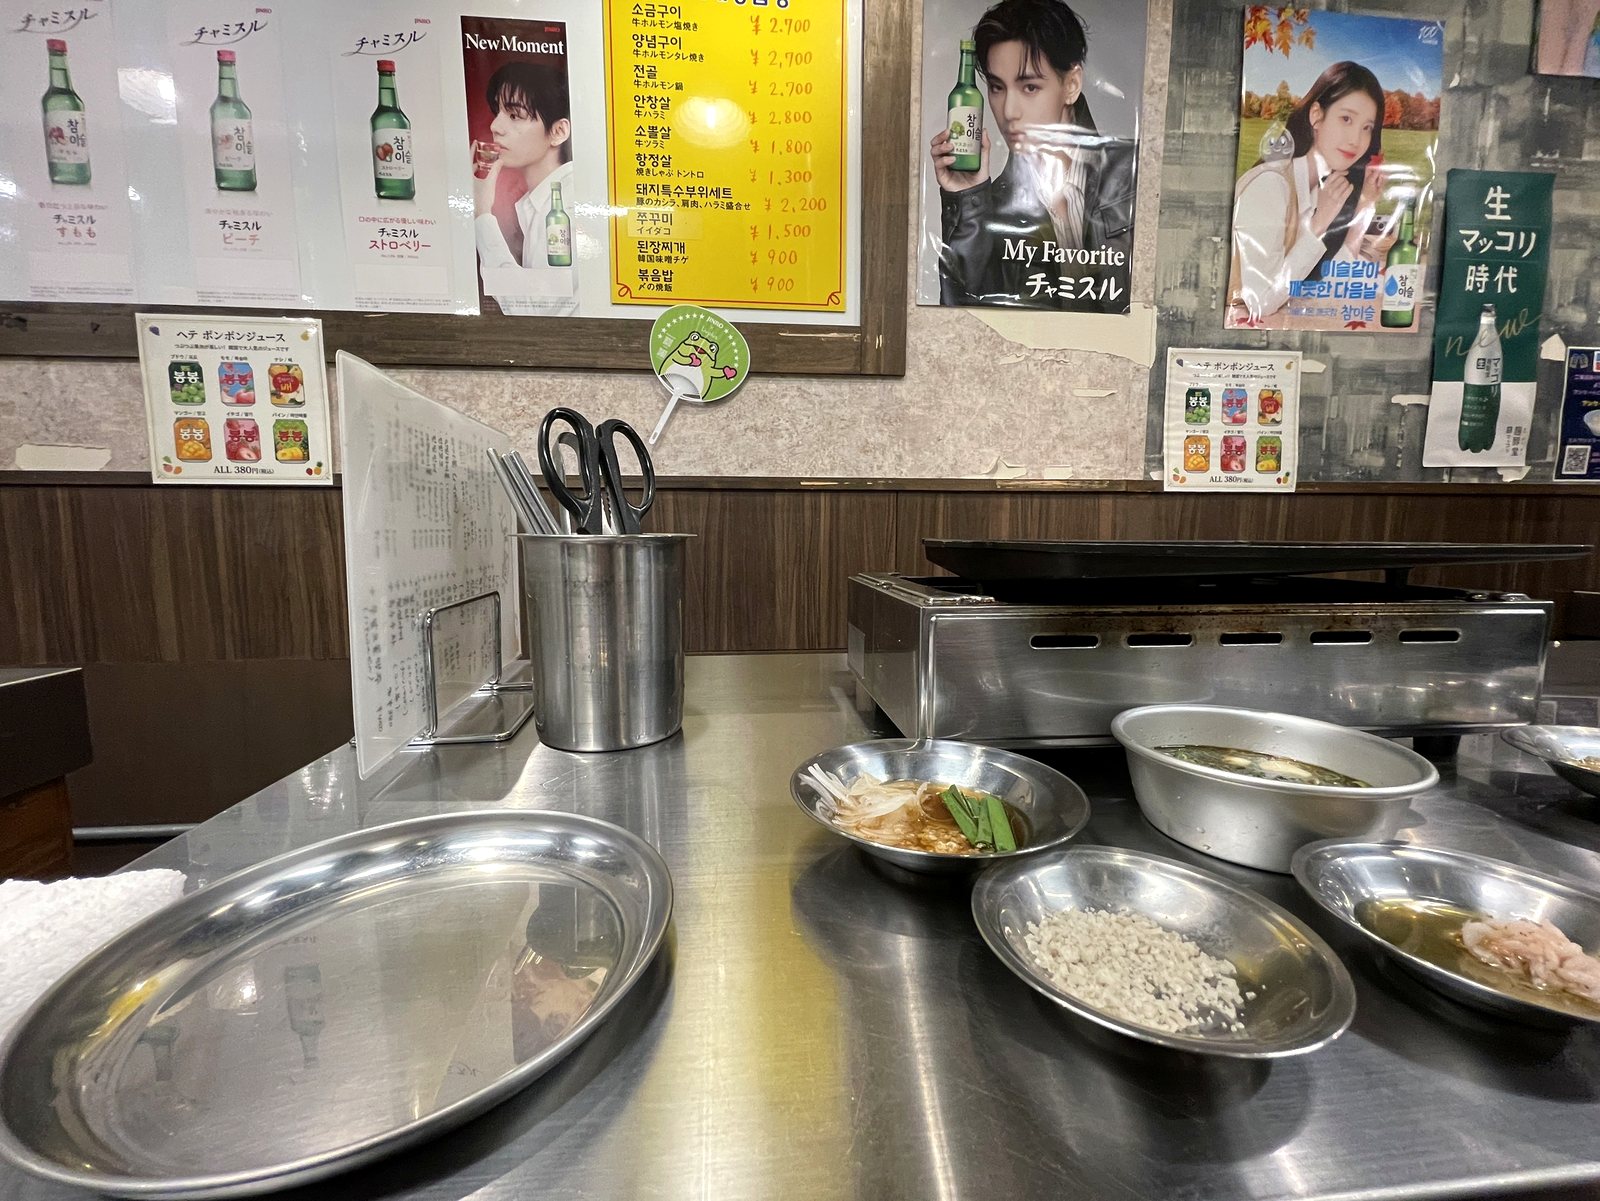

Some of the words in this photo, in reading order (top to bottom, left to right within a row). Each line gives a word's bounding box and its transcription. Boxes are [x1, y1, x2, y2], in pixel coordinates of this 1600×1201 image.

[632, 3, 681, 19] 소금구이
[14, 8, 98, 33] チャミスル
[632, 18, 699, 31] 牛ホルモン塩焼き
[187, 20, 268, 44] チャミスル
[348, 31, 426, 55] チャミスル
[465, 33, 499, 50] New
[501, 35, 564, 54] Moment
[632, 34, 682, 50] 양념구이
[632, 49, 705, 63] 牛ホルモンタレ焼き
[633, 65, 658, 79] 전골
[633, 79, 684, 91] 牛ホルモン鍋
[633, 95, 671, 110] 안창살
[634, 109, 665, 120] 牛ハラミ
[635, 139, 665, 149] 牛ツラミ
[636, 153, 672, 168] 항정살
[636, 168, 674, 178] 焼きしゃぶ
[677, 170, 704, 179] トントロ
[636, 183, 733, 199] 돼지특수부위세트
[1484, 185, 1512, 220] 生
[53, 214, 97, 225] チャミスル
[219, 219, 262, 231] チャミスル
[636, 212, 673, 226] 쭈꾸미
[57, 226, 96, 238] すもも
[378, 227, 419, 239] チャミスル
[637, 227, 671, 237] イイダコ
[369, 239, 431, 252] ストロベリー
[637, 240, 686, 255] 된장찌개
[1459, 229, 1537, 258] マッコリ
[637, 254, 689, 265] 韓国味噌チゲ
[768, 249, 798, 265] 900
[1002, 238, 1038, 267] My
[1042, 241, 1125, 266] Favorite
[638, 269, 674, 283] 볶음밥
[1321, 260, 1379, 279] 이슬같이
[767, 276, 795, 292] 900
[1465, 264, 1518, 293] 時代
[1025, 272, 1124, 300] チャミスル
[1335, 281, 1378, 299] 다음날
[1341, 305, 1376, 321] 참이슬
[176, 330, 198, 340] ヘテ
[173, 370, 200, 384] 봉봉
[213, 465, 232, 474] ALL
[1209, 475, 1222, 483] ALL
